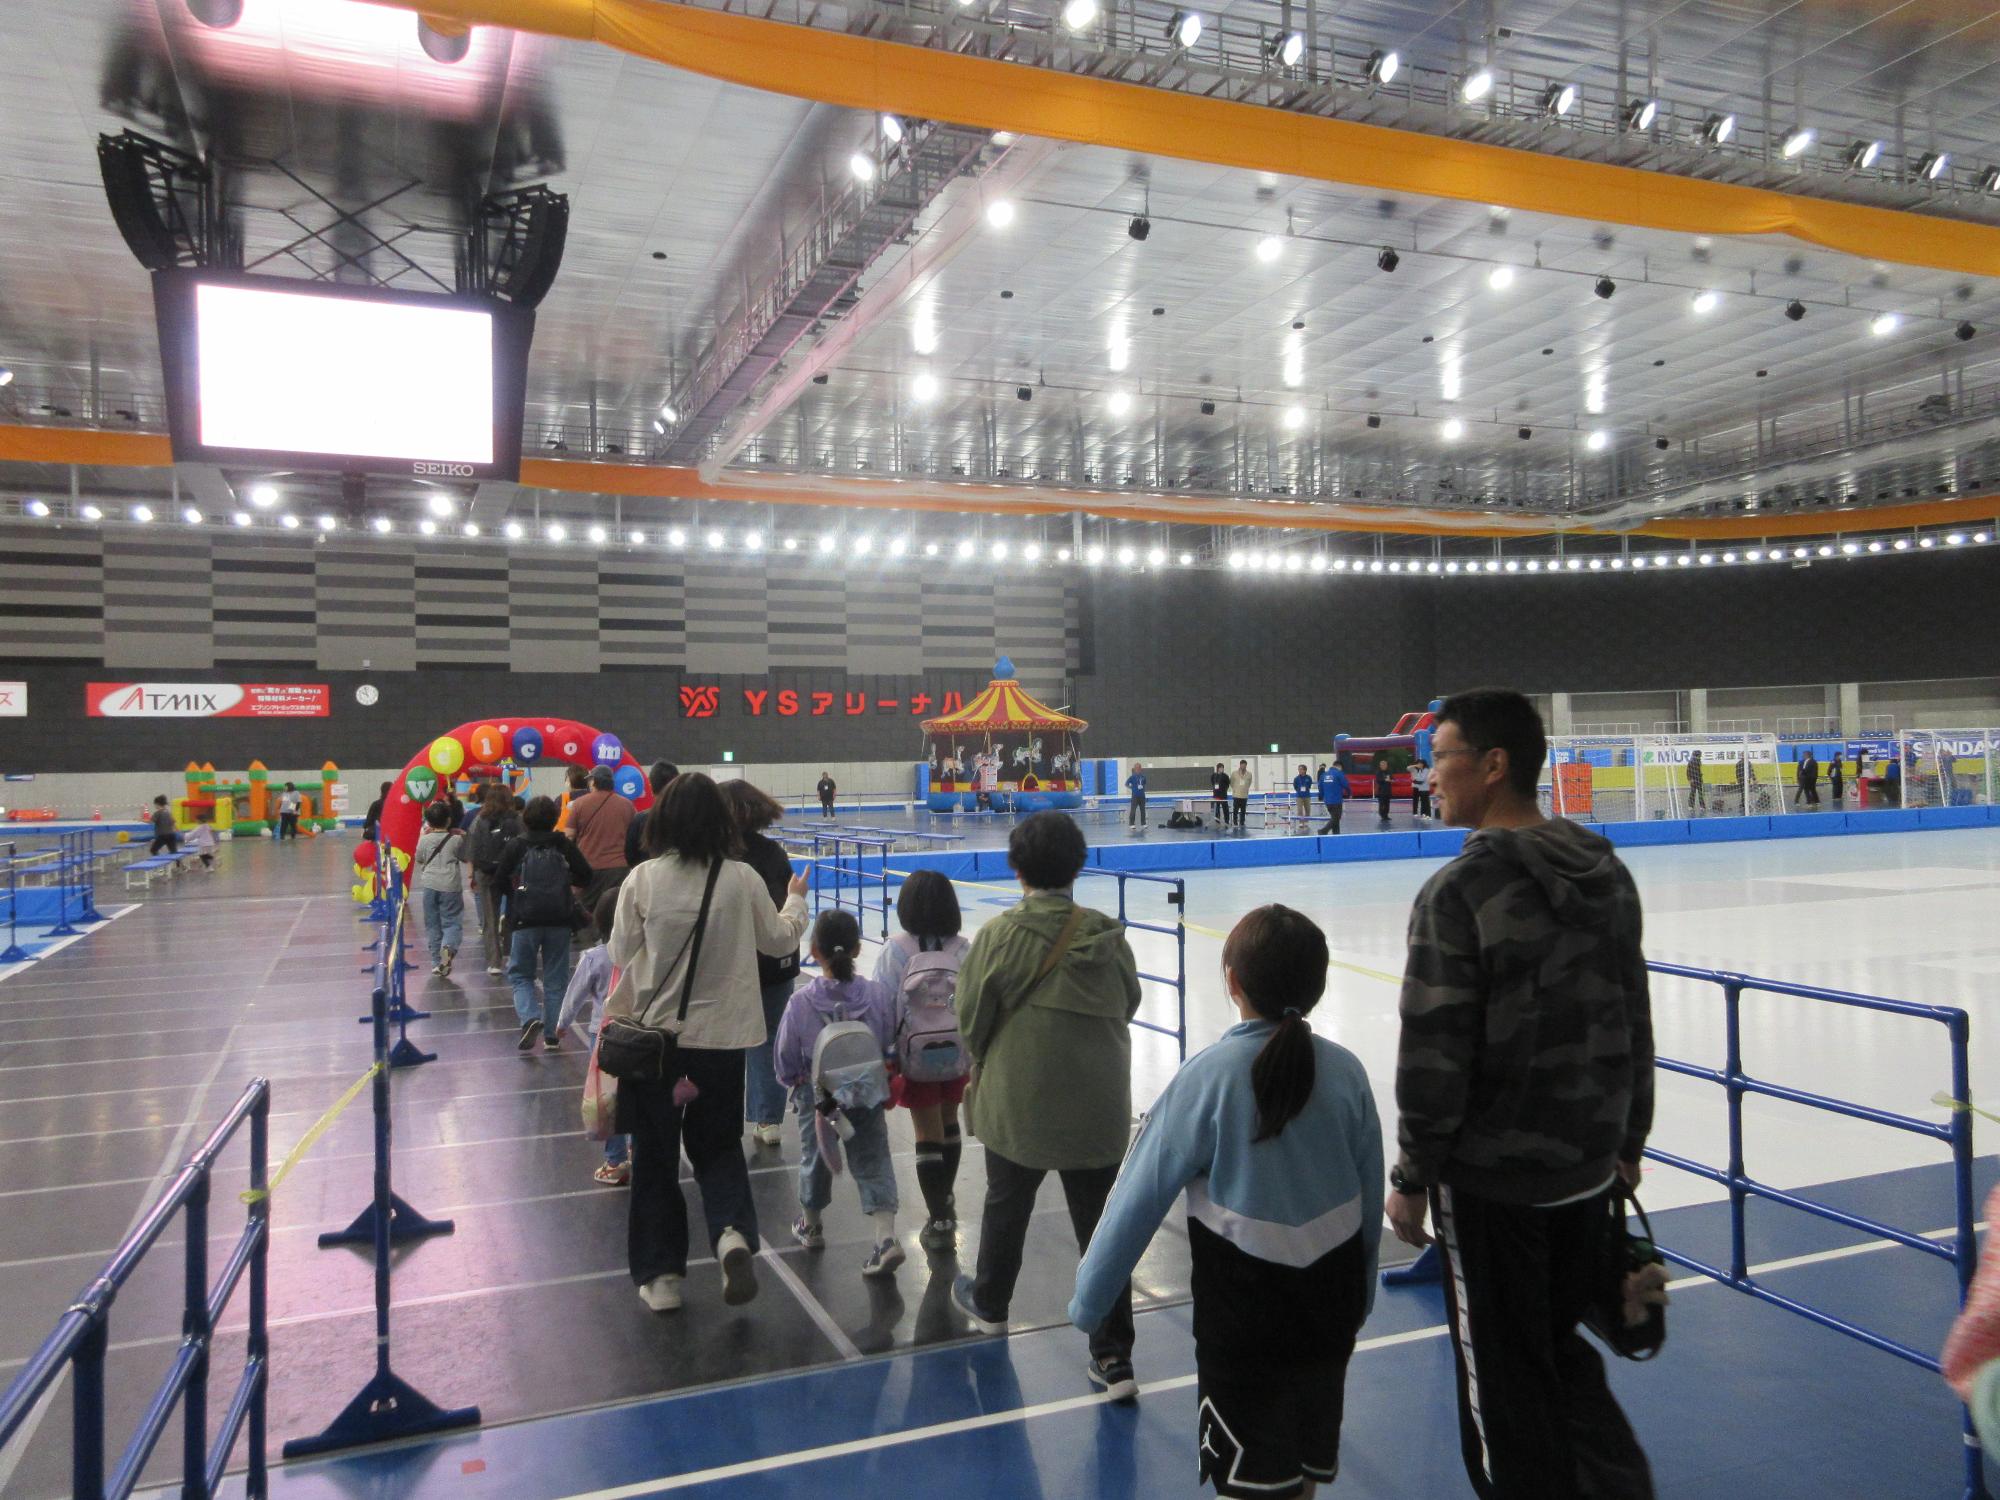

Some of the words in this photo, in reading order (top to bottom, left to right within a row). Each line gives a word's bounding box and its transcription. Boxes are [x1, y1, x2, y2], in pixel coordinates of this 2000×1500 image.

[413, 462, 474, 477] SEIKO
[119, 687, 217, 710] ATMIX
[1657, 750, 1700, 763] MIUR
[1912, 740, 2000, 758] SNDAY
